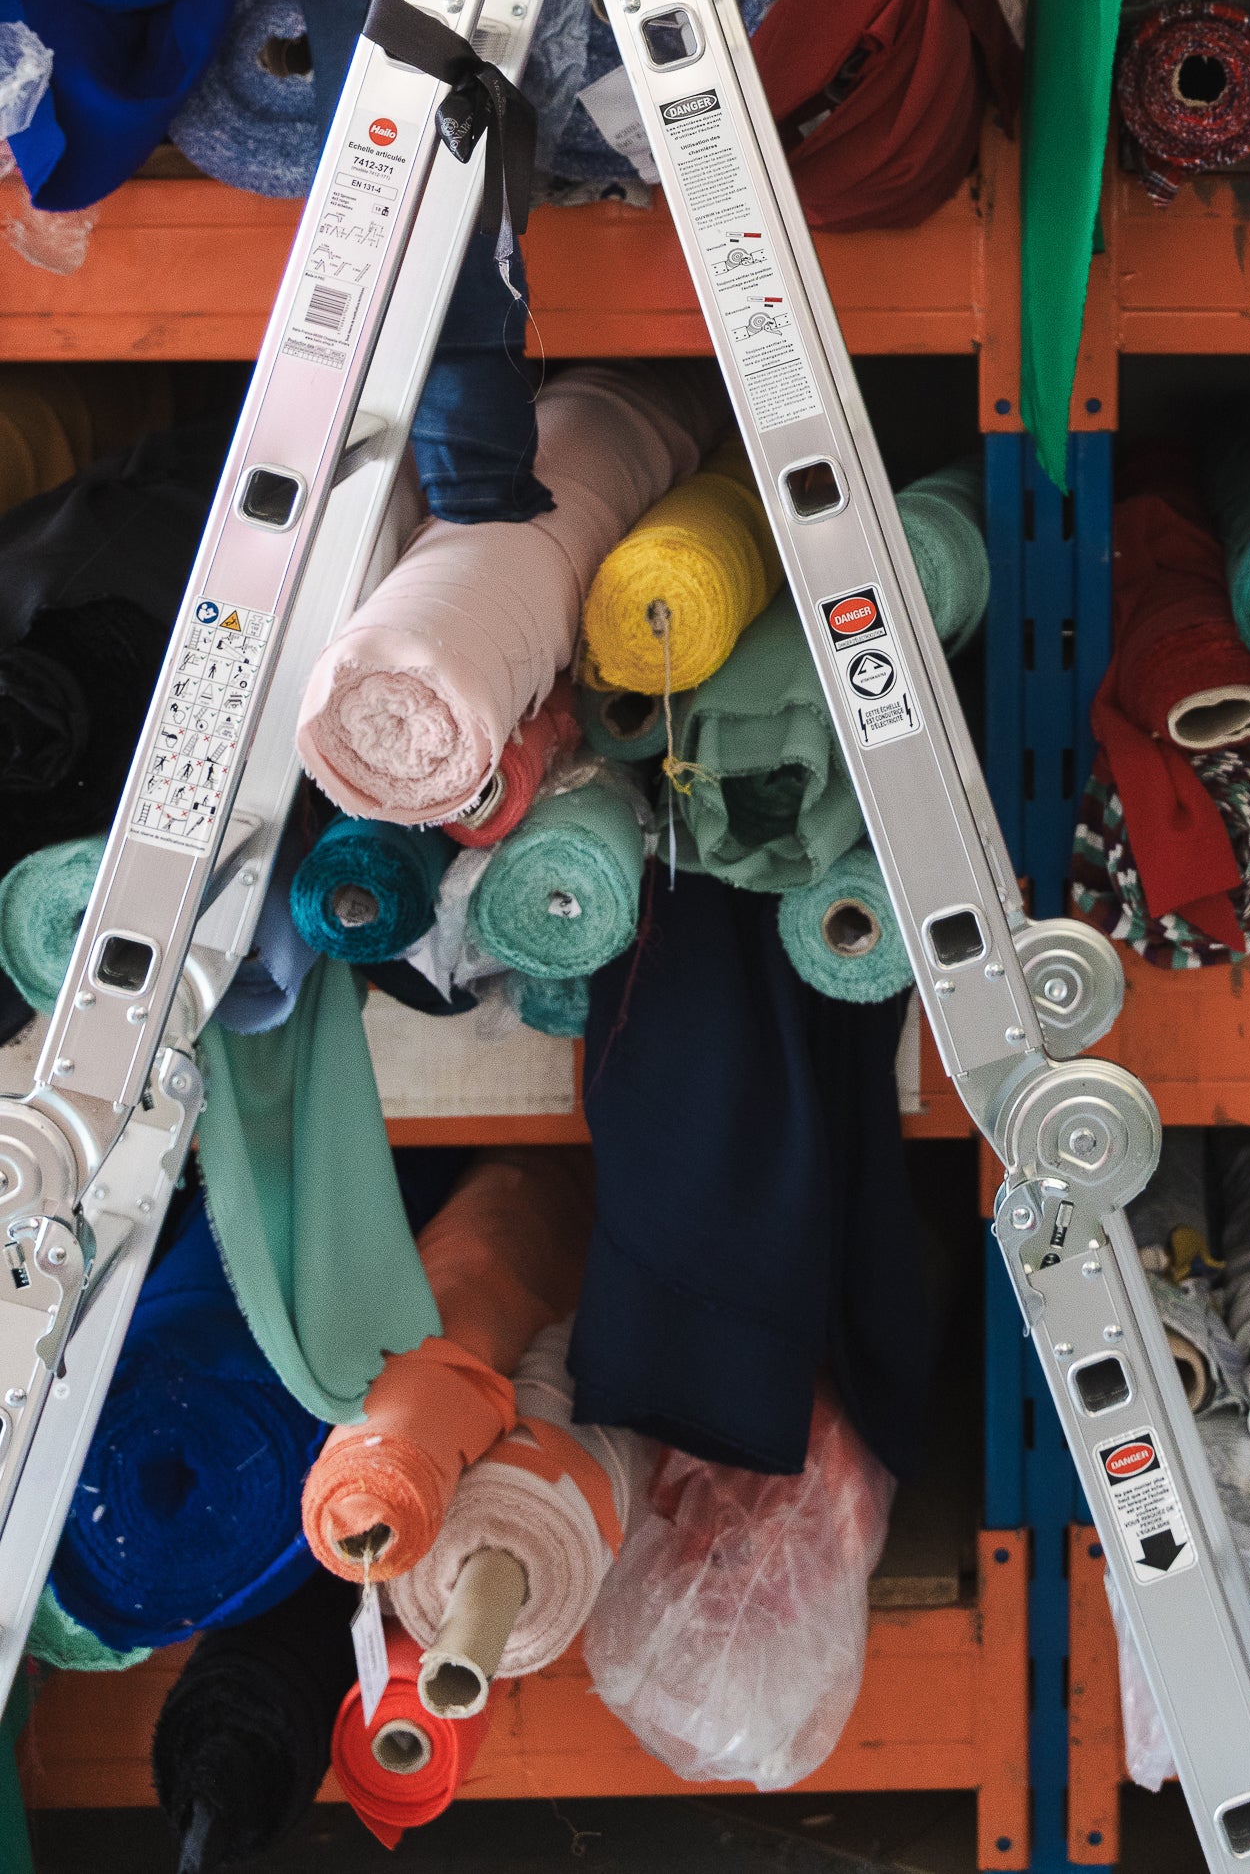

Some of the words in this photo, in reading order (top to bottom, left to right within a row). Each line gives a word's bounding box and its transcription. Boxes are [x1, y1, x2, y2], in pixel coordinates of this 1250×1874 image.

[669, 96, 712, 117] DANGER
[370, 124, 397, 139] Hailo
[348, 141, 375, 154] Echelle
[375, 149, 407, 163] articulée
[353, 156, 395, 174] 7412-371
[351, 179, 362, 187] EN
[363, 183, 382, 193] 131-4
[834, 607, 872, 625] DANGER
[865, 708, 880, 717] CETTE
[1110, 1449, 1149, 1470] DANGER
